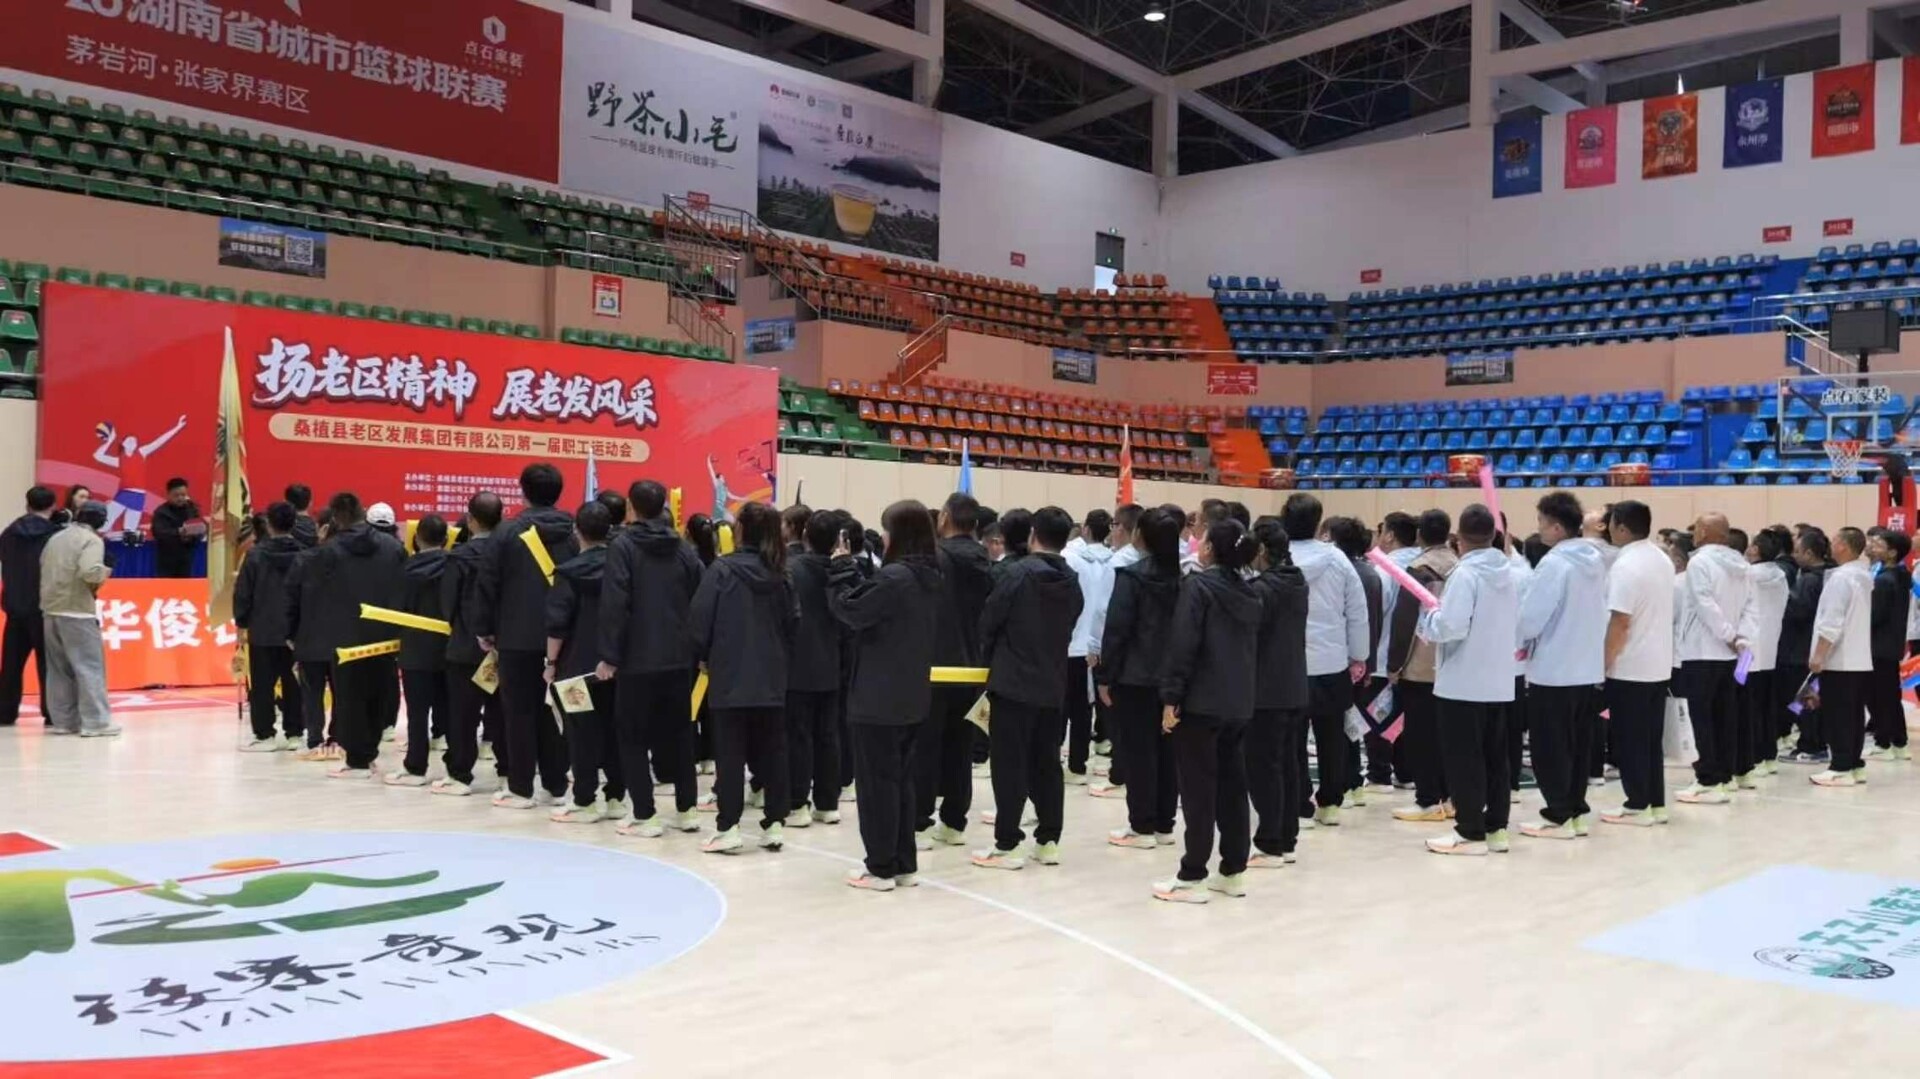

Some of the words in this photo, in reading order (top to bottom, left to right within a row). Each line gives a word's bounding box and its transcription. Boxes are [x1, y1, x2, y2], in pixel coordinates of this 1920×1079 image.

[66, 34, 310, 114] 茅岩河·张家界赛区
[253, 338, 477, 417] 扬老区精神
[493, 369, 658, 427] 展老发风采
[294, 417, 633, 459] 桑植县老区发展集团有限公司第一届职工运动会
